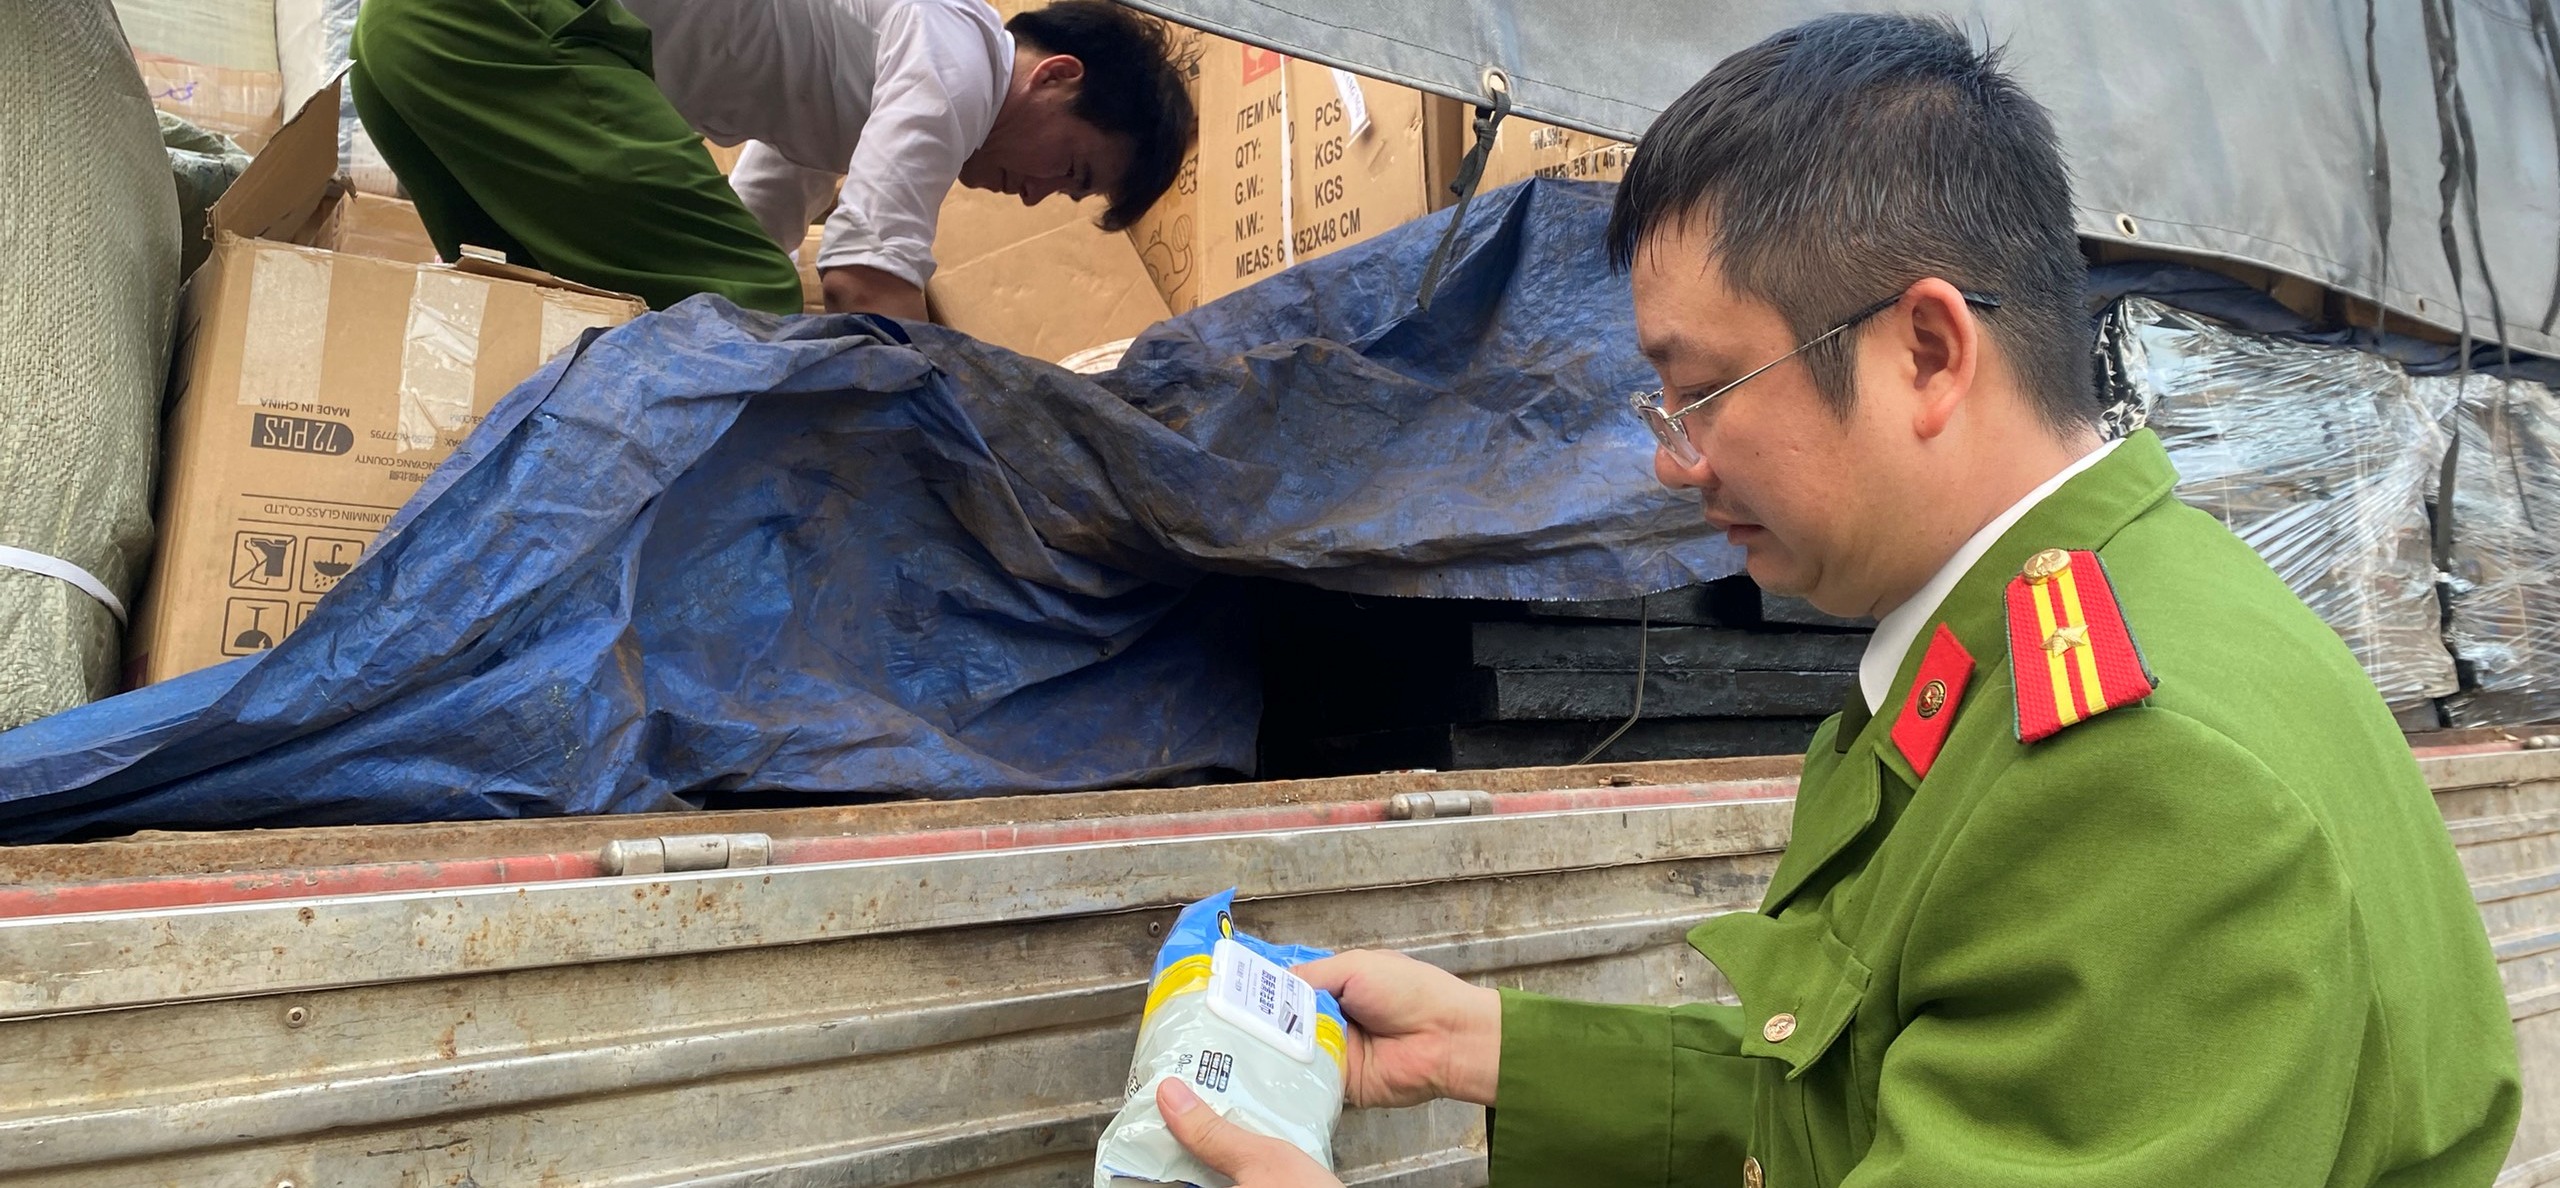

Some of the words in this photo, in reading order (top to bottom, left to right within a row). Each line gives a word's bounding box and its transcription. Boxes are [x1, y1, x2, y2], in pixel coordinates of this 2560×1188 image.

[1236, 100, 1264, 134] ITEM
[1235, 138, 1262, 169] QTY:
[1314, 98, 1342, 132] PCS
[1234, 174, 1264, 206] G.W.:
[1314, 136, 1343, 170] KGS
[1235, 211, 1264, 243] N.W.:
[1314, 174, 1344, 209] KGS
[1236, 244, 1274, 279] MEAS:
[1276, 218, 1337, 263] 6X52X48
[1340, 207, 1361, 238] CM
[260, 397, 299, 412] CHINA
[301, 402, 314, 413] IN
[316, 404, 351, 418] MADE
[262, 416, 309, 450] PCS
[312, 422, 338, 453] 72
[354, 453, 395, 467] COUNTY
[306, 507, 341, 520] GLASS
[341, 510, 381, 524] XINMIN
